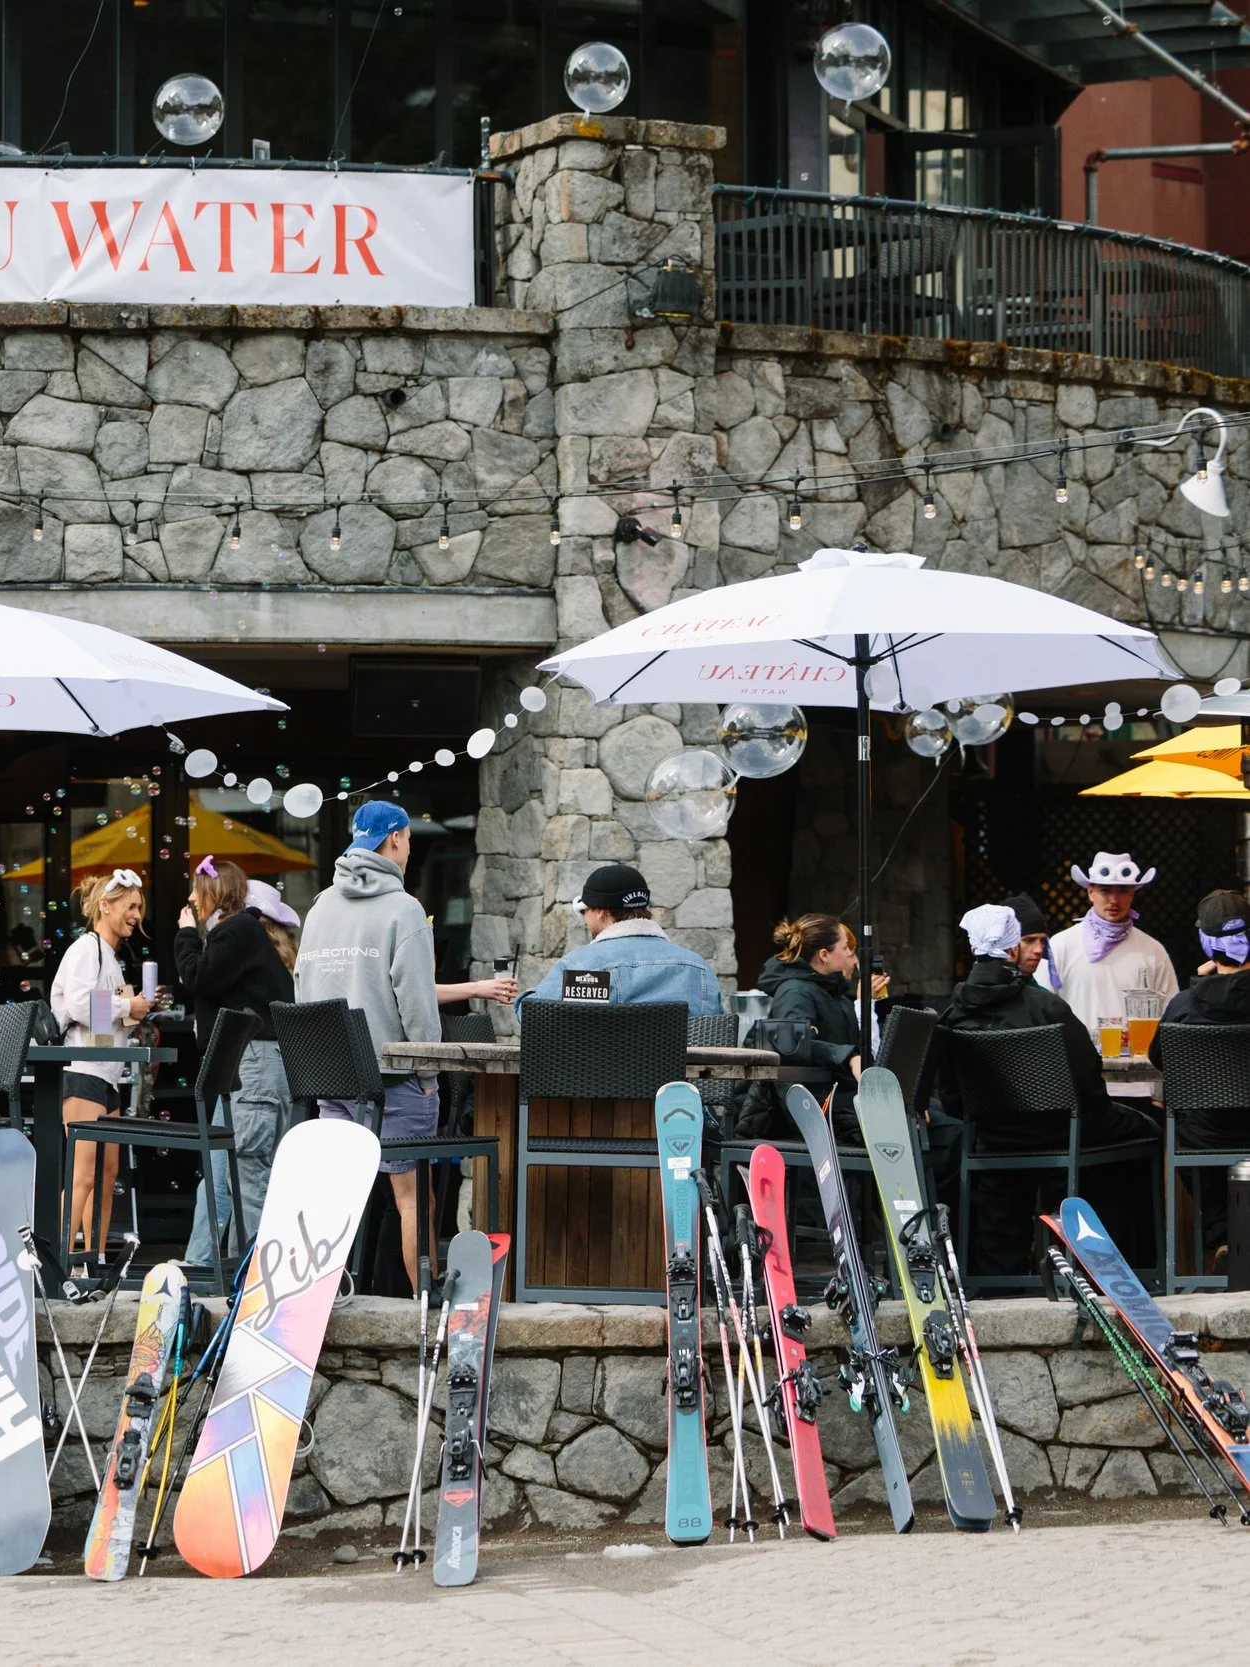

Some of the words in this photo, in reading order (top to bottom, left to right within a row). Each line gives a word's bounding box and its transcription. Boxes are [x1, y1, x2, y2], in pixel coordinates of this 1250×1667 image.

[51, 200, 385, 275] WATER
[300, 947, 380, 961] REFLECTIONS
[565, 986, 608, 998] RESERVED
[244, 1210, 351, 1332] Lib
[1084, 1245, 1175, 1343] ATOMIC
[678, 1517, 702, 1528] 88
[448, 1526, 463, 1569] NORDICA
